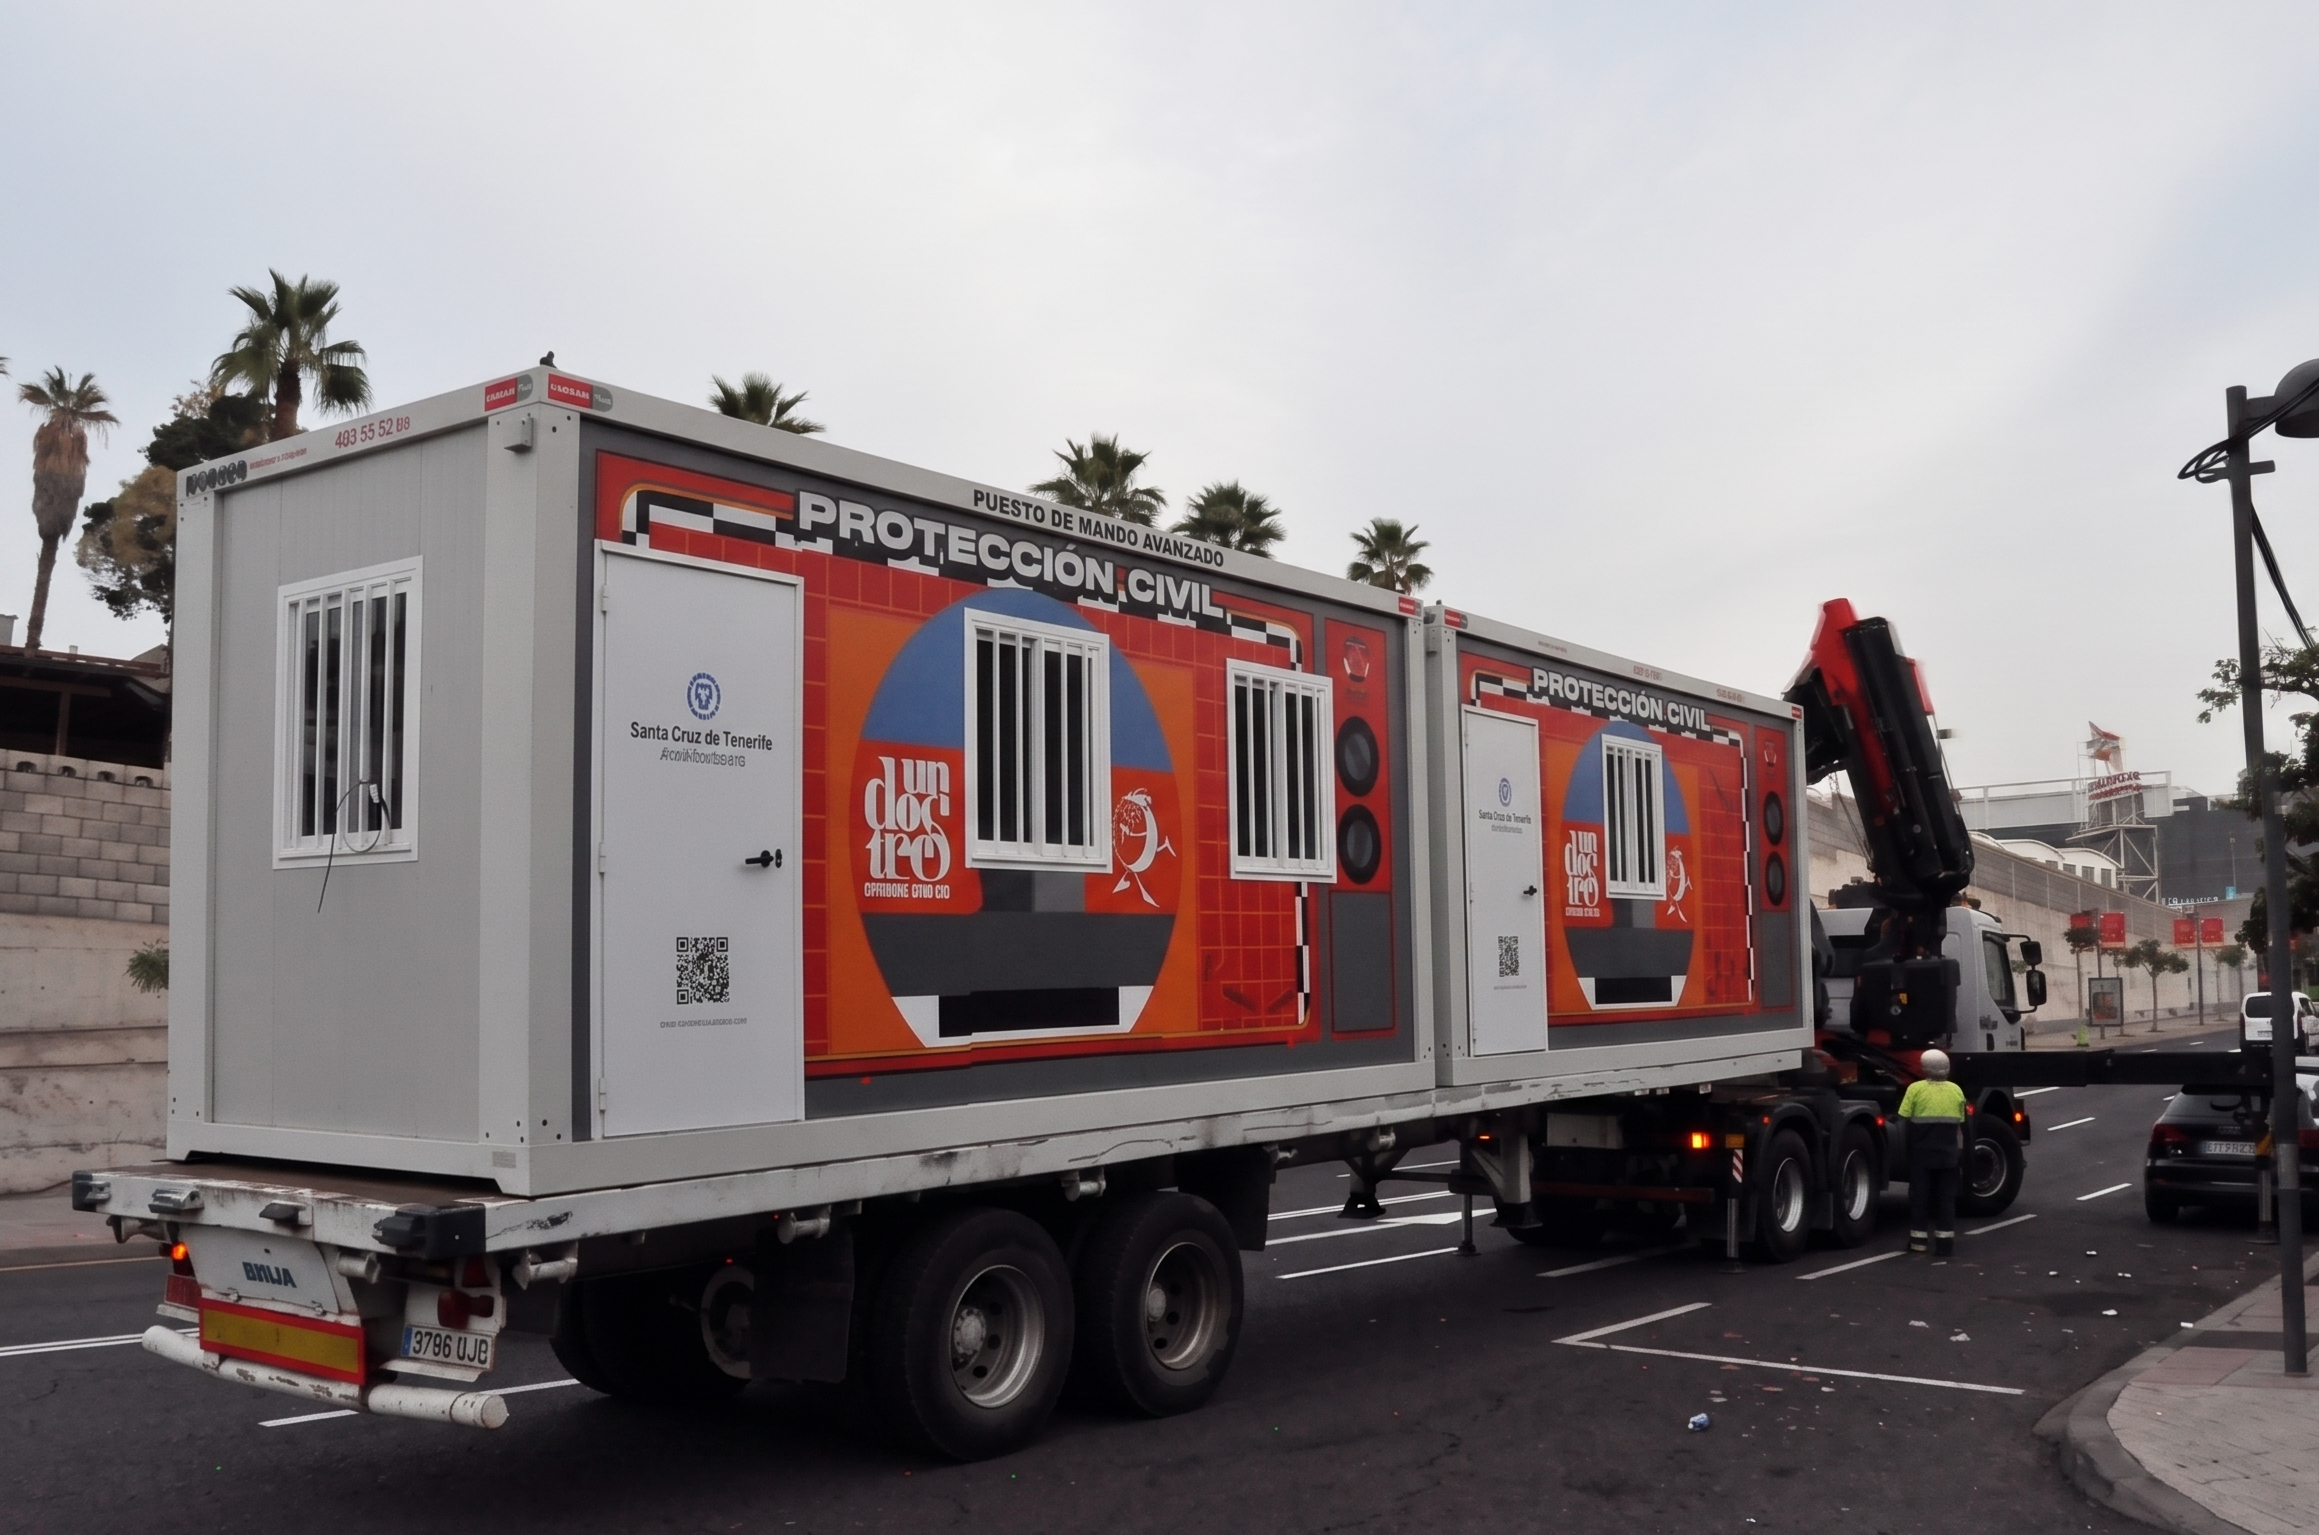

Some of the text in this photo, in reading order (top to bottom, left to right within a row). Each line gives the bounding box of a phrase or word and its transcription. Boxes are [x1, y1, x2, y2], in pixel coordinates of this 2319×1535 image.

[360, 423, 375, 442] 55
[378, 418, 393, 437] 52
[799, 490, 1223, 618] PROTECCIÓN CIVIL
[973, 489, 1224, 567] PUESTO DE MANDO AVANZADO
[1533, 667, 1711, 732] PROTECCIÓN CIVIL
[630, 721, 773, 751] Santa Cruz de Tenerife
